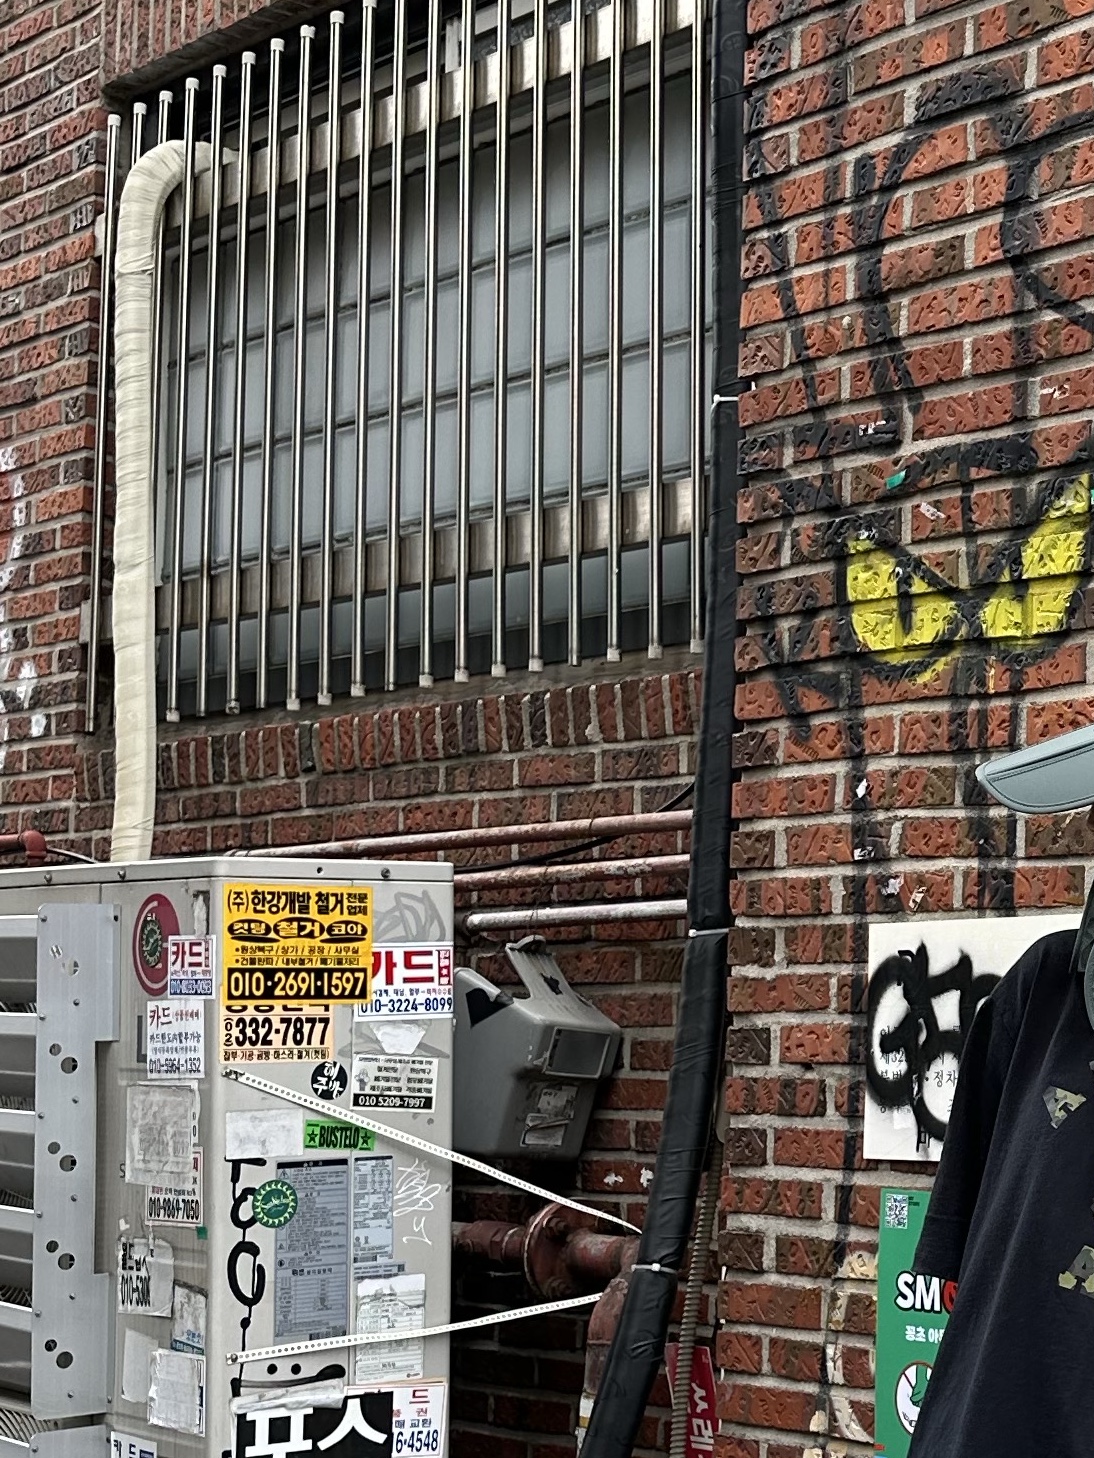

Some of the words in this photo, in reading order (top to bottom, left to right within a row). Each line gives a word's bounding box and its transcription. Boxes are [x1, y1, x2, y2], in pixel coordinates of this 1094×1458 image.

[315, 891, 344, 915] 철거
[346, 892, 368, 904] 전문
[277, 921, 321, 937] 철거
[331, 923, 363, 935] 코아
[173, 941, 202, 969] 카드
[149, 1005, 173, 1030] 카드
[234, 1016, 330, 1047] 332-7877
[318, 1126, 360, 1149] BUSTELO
